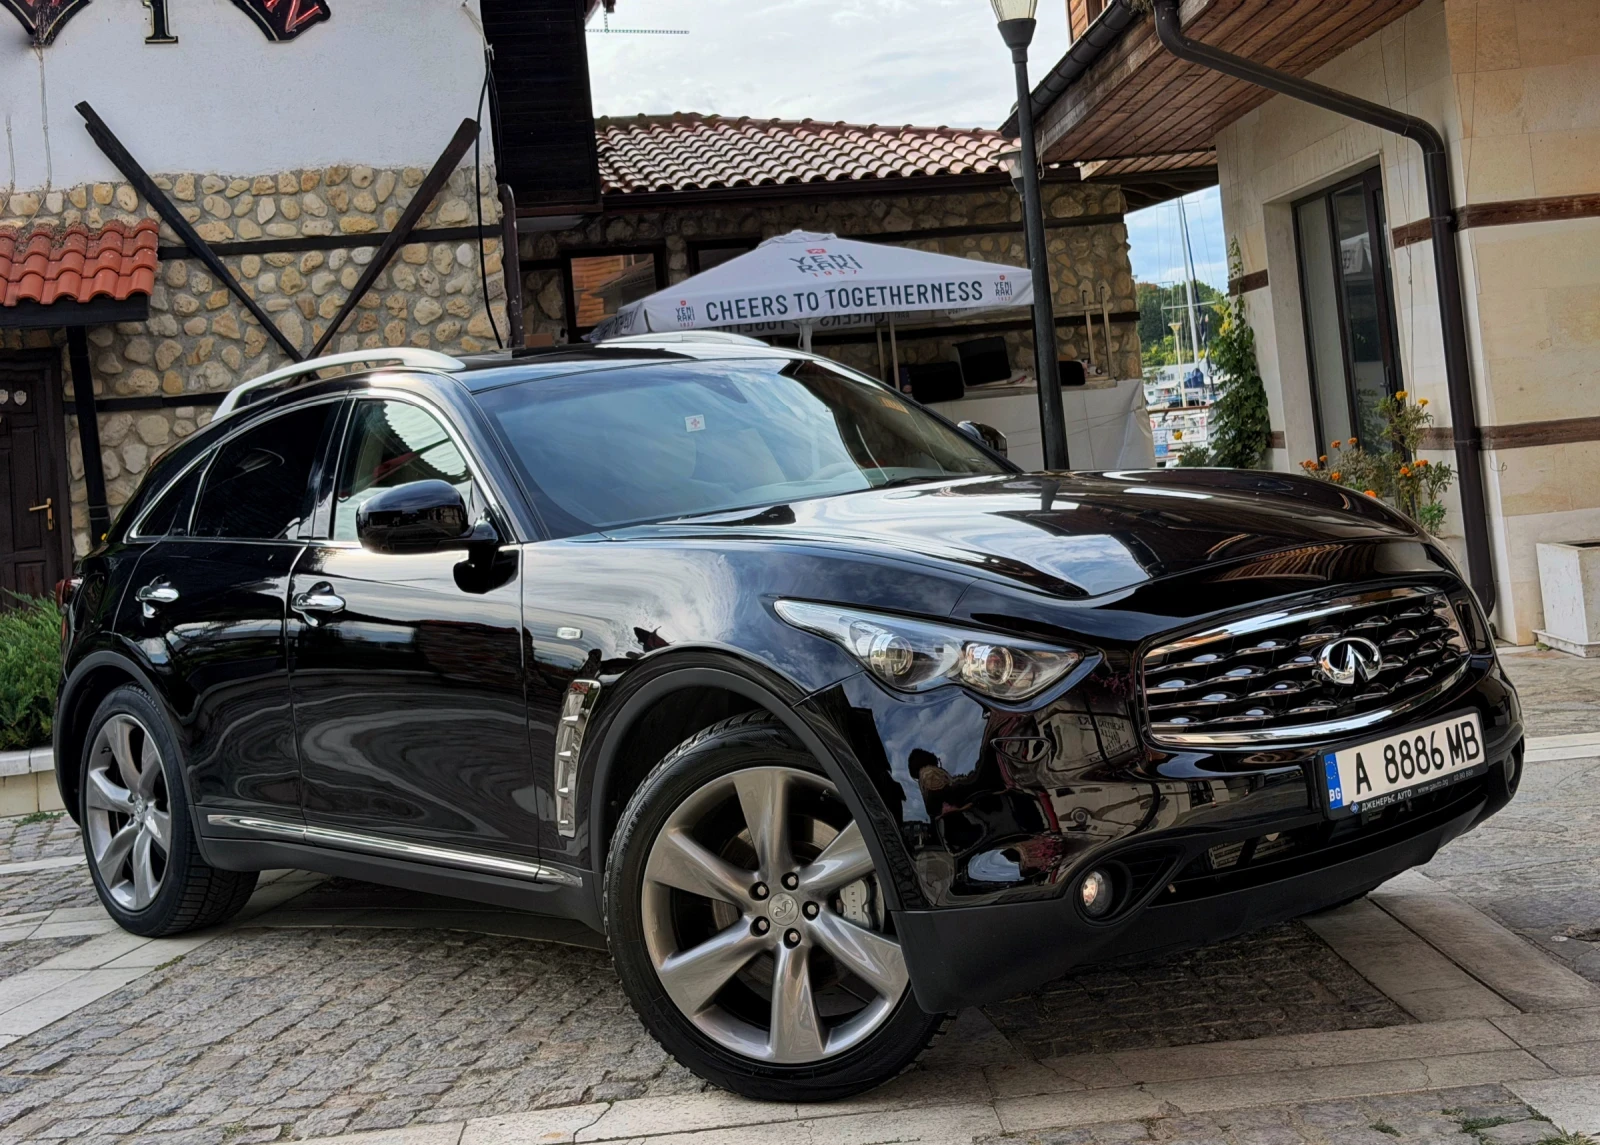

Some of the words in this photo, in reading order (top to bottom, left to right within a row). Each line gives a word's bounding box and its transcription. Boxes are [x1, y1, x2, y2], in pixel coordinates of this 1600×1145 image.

[705, 294, 789, 322] CHEERS
[793, 291, 819, 313] TO
[825, 280, 983, 310] TOGETHERNESS
[1355, 751, 1373, 795] A
[1383, 730, 1445, 784] 8886
[1446, 720, 1480, 767] MB
[1328, 787, 1342, 802] BG
[1361, 795, 1396, 812] ДЖЕНЕРЪС
[1397, 789, 1413, 801] АУТО
